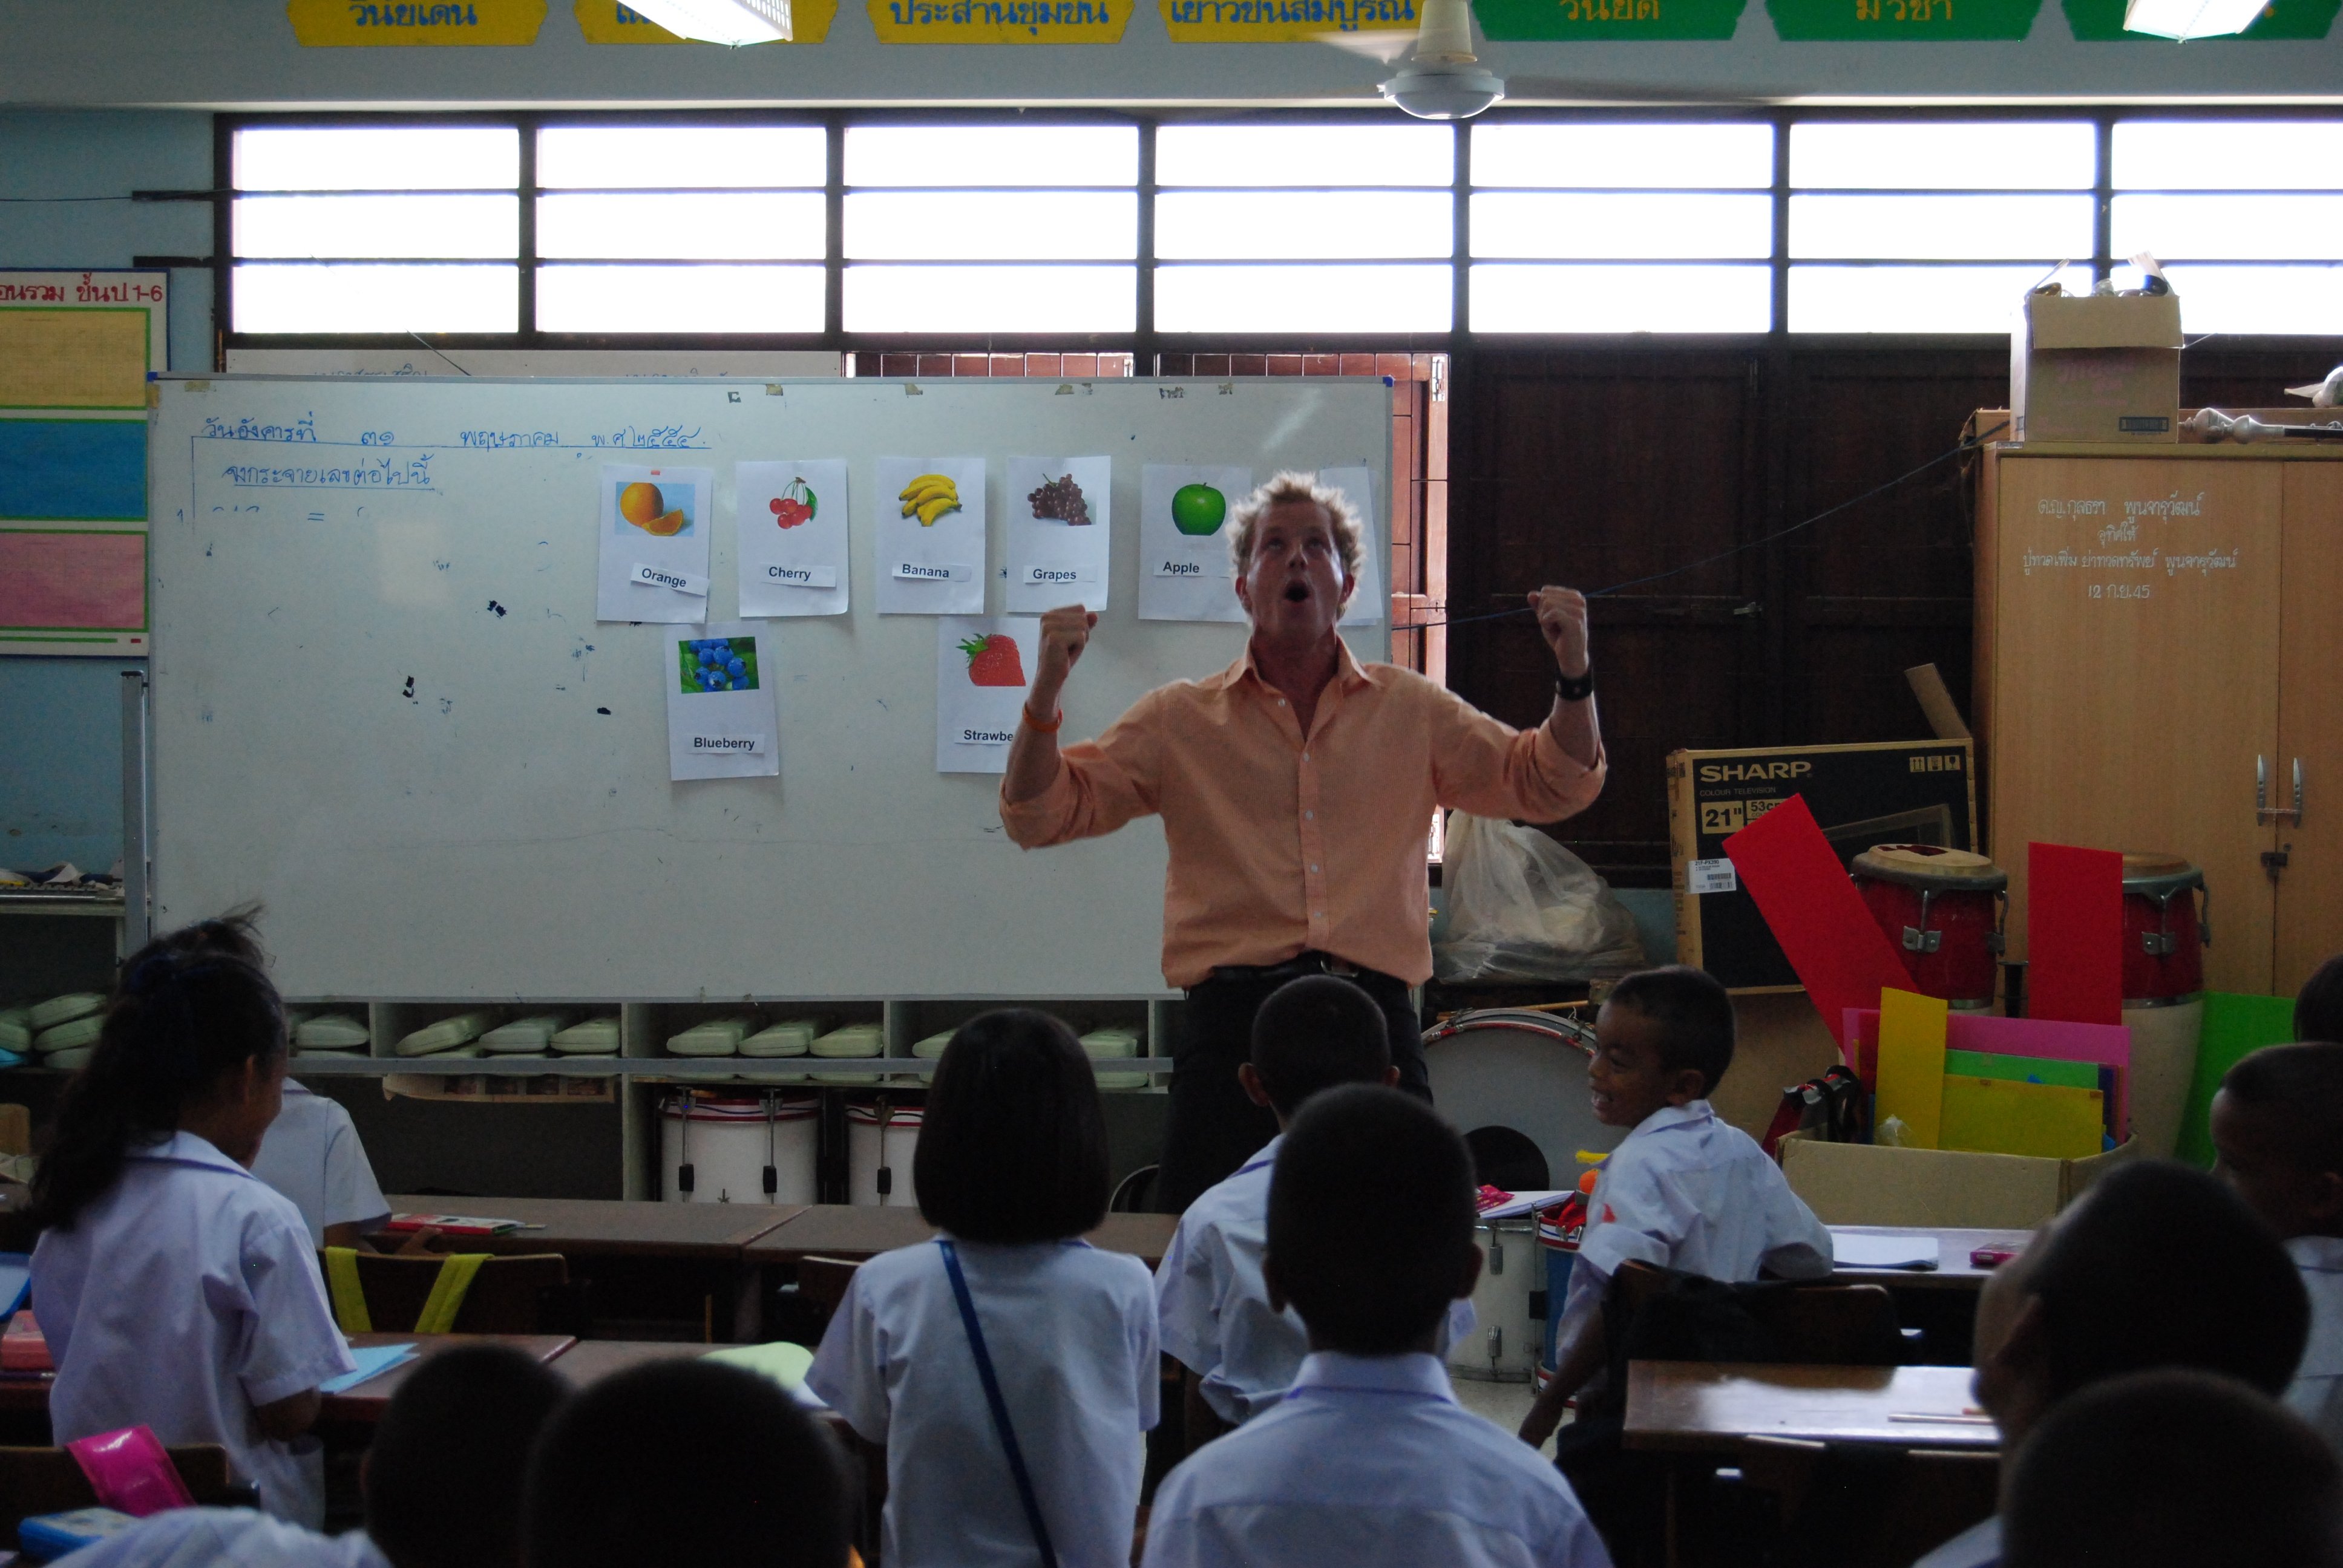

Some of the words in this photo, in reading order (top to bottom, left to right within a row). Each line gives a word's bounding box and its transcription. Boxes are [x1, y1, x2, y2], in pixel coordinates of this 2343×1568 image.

[1171, 0, 1415, 32] เยาวชนสมบูรณ
[768, 566, 811, 581] Cherry
[902, 563, 949, 578] Banana
[1032, 568, 1076, 582] Grapes
[1162, 561, 1201, 575] Apple
[641, 567, 687, 588] Orange
[963, 729, 1014, 742] Strawbe
[693, 737, 755, 751] Blueberry
[1699, 761, 1812, 783] SHARP
[1699, 789, 1731, 797] COLOUR
[1734, 786, 1777, 796] TELEVISION
